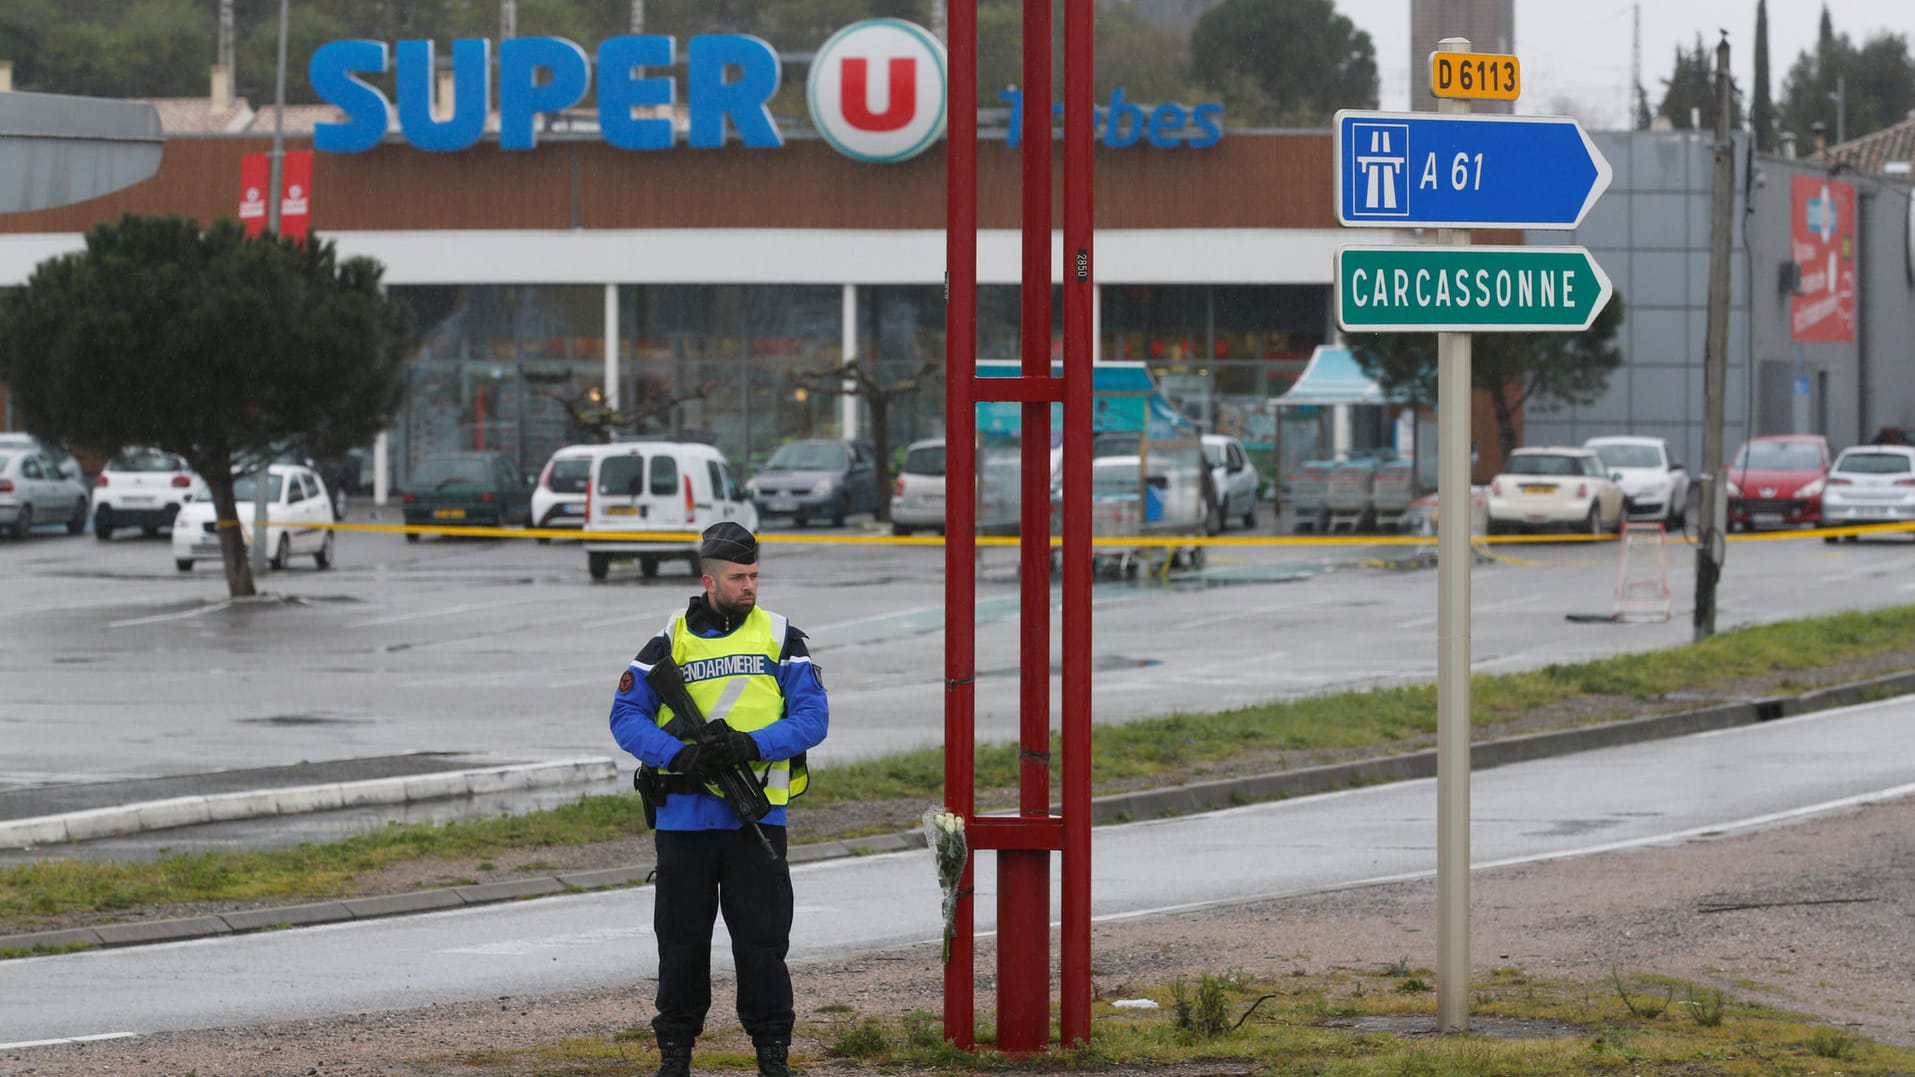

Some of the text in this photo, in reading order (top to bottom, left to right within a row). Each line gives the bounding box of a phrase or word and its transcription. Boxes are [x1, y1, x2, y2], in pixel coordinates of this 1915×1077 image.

[309, 34, 916, 153] SUPER U
[1440, 59, 1516, 91] D 6113
[1000, 88, 1224, 149] Tbes
[1420, 152, 1484, 191] A 61
[1077, 254, 1088, 277] 2850
[1352, 268, 1576, 308] CARCASSONNE
